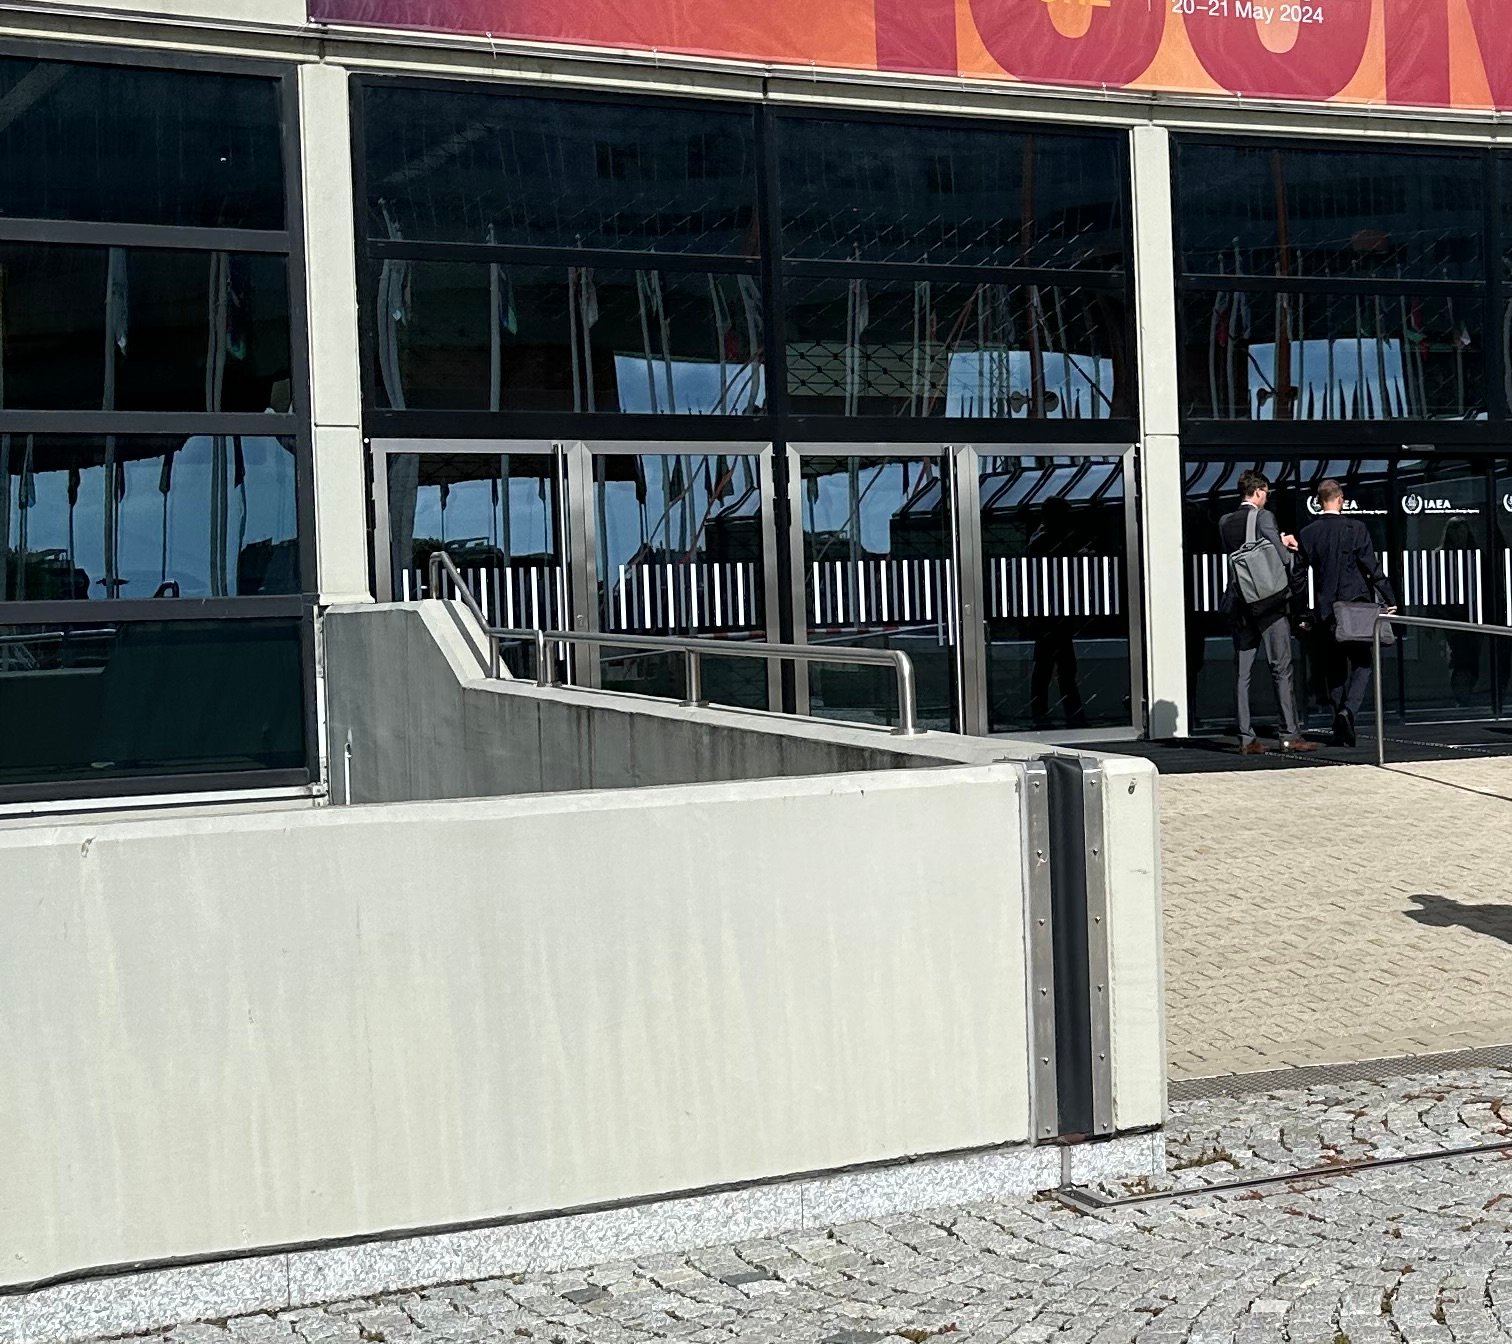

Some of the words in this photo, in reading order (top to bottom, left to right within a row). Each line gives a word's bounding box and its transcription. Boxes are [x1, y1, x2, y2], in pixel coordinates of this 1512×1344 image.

[1235, 1, 1274, 25] May
[1280, 5, 1324, 24] 2024
[1424, 499, 1451, 509] IAEA
